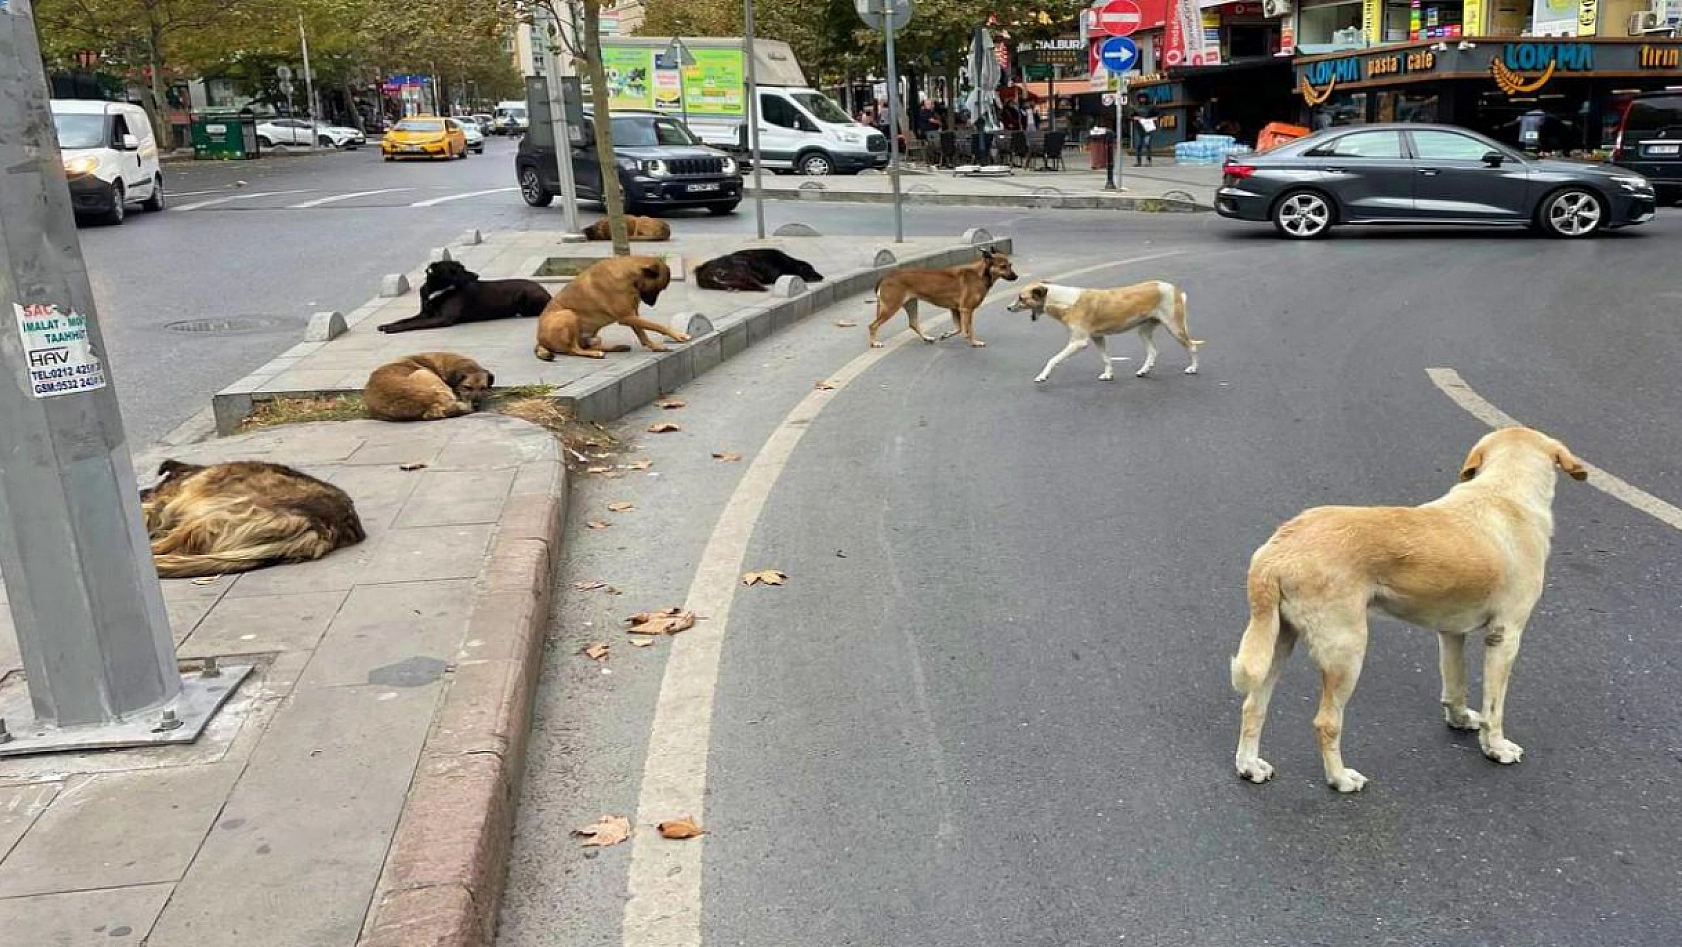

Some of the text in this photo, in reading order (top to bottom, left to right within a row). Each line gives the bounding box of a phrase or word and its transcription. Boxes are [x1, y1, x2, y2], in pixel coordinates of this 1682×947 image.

[1308, 57, 1360, 84] LOKMA
[1367, 56, 1397, 77] pasta
[1504, 43, 1593, 70] LOKMA
